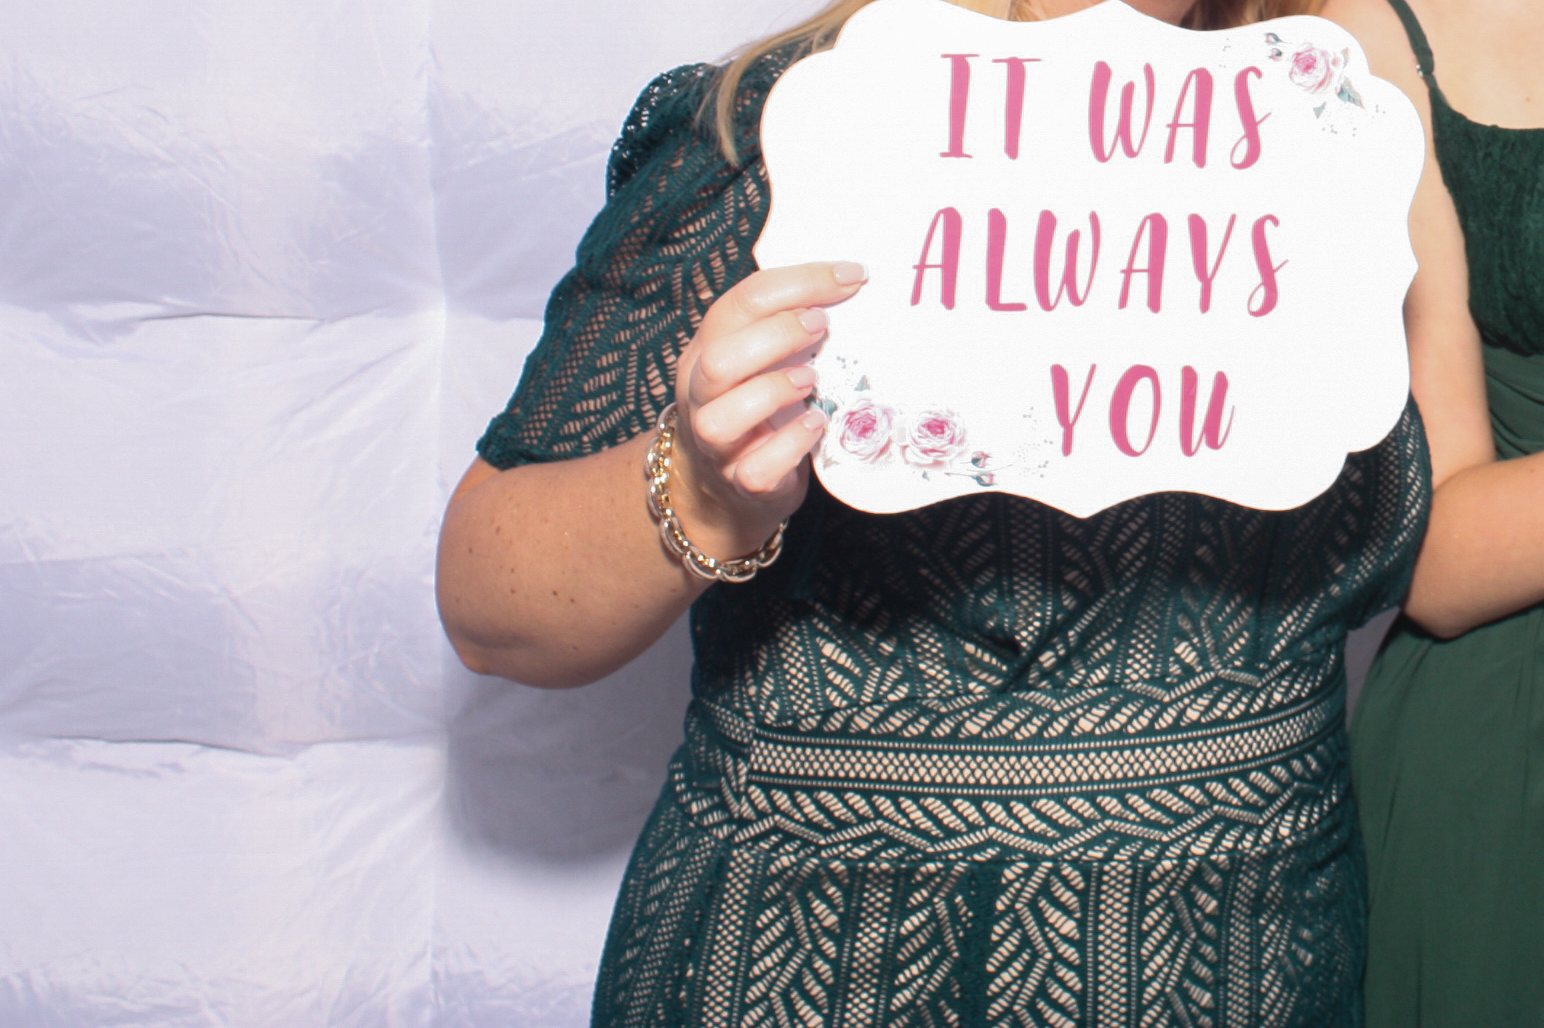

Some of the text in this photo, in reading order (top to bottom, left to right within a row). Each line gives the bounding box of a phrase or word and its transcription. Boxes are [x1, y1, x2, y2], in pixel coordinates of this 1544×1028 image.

[939, 53, 1271, 170] IT WAS
[910, 206, 1288, 318] ALWAYS
[1049, 363, 1234, 458] YOU
